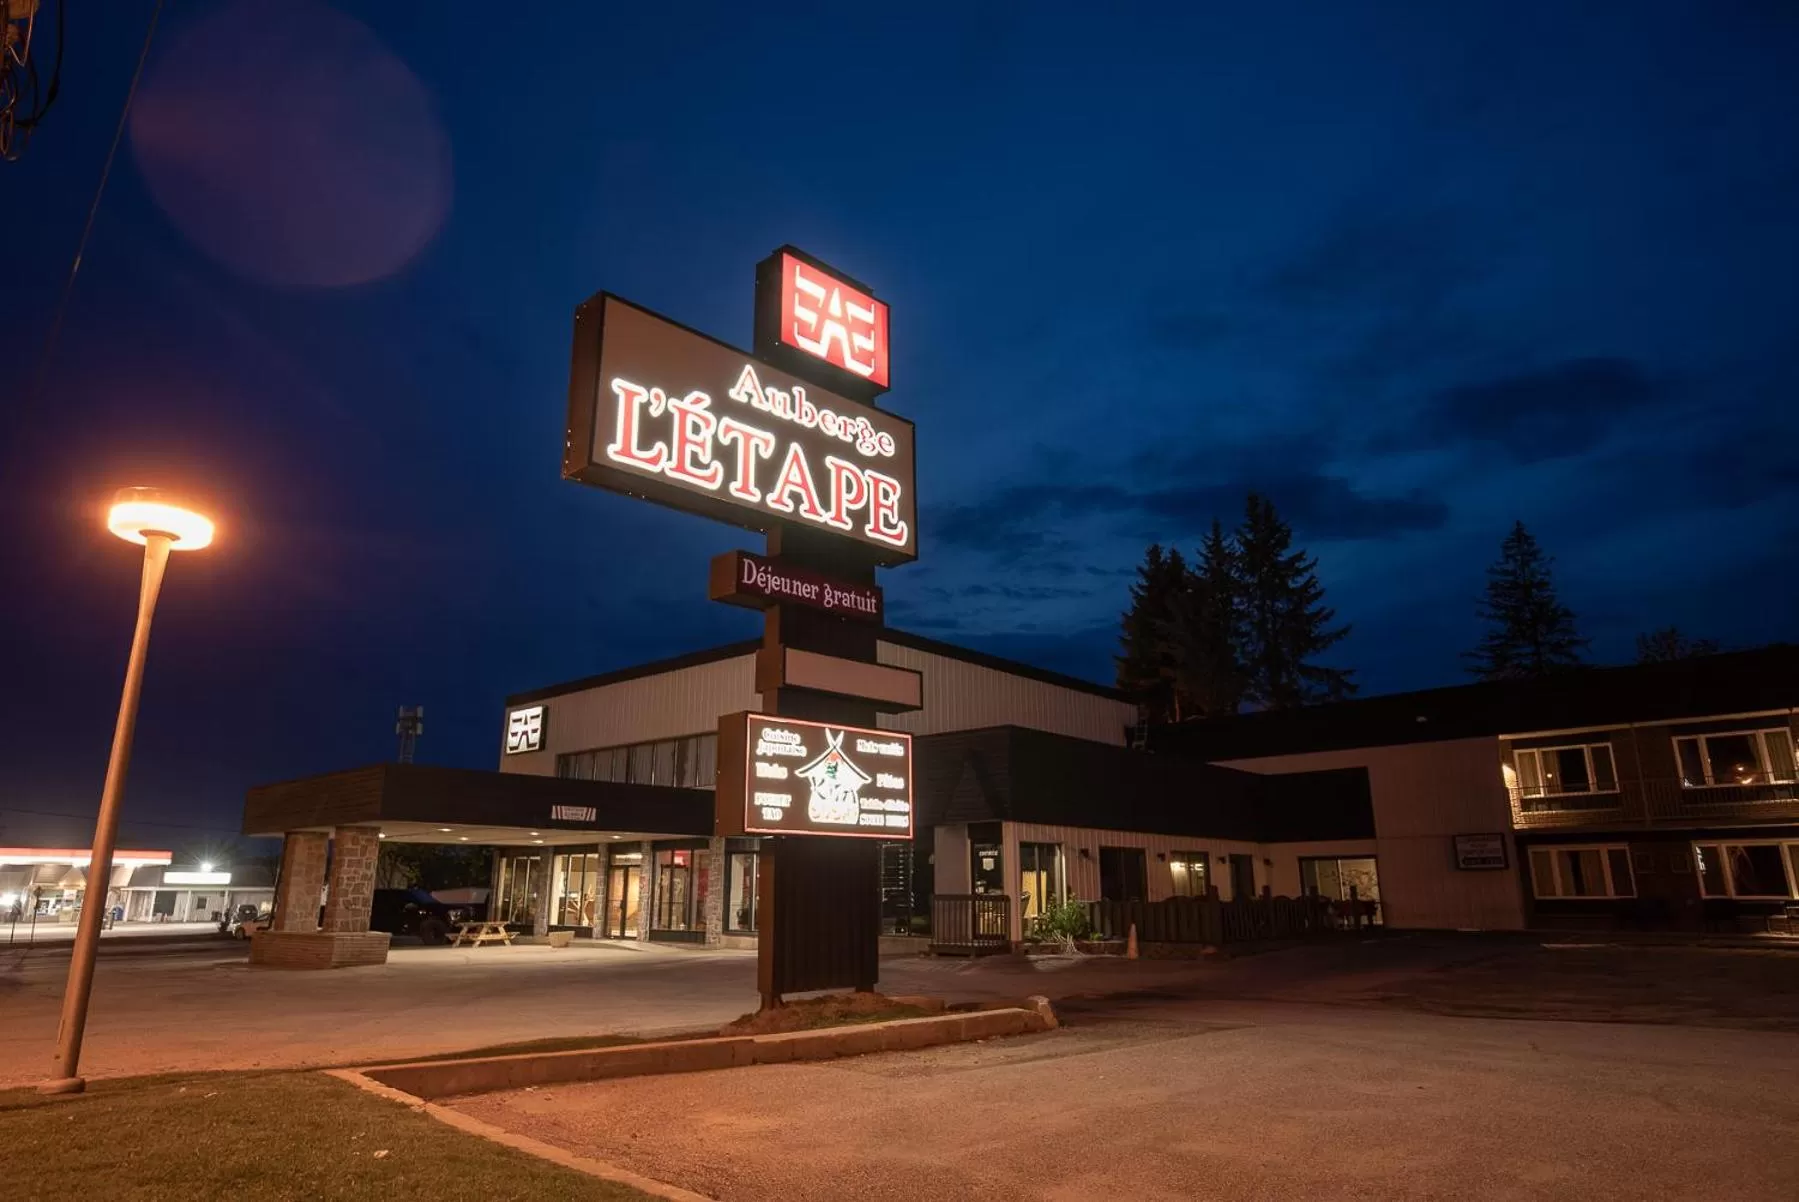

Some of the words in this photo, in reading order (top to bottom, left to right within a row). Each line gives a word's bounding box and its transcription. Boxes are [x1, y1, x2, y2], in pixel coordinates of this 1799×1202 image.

[729, 364, 896, 457] Auberge
[607, 377, 908, 546] L'ÉTAPE
[742, 558, 820, 600] Déjeuner
[823, 583, 877, 613] gratuit
